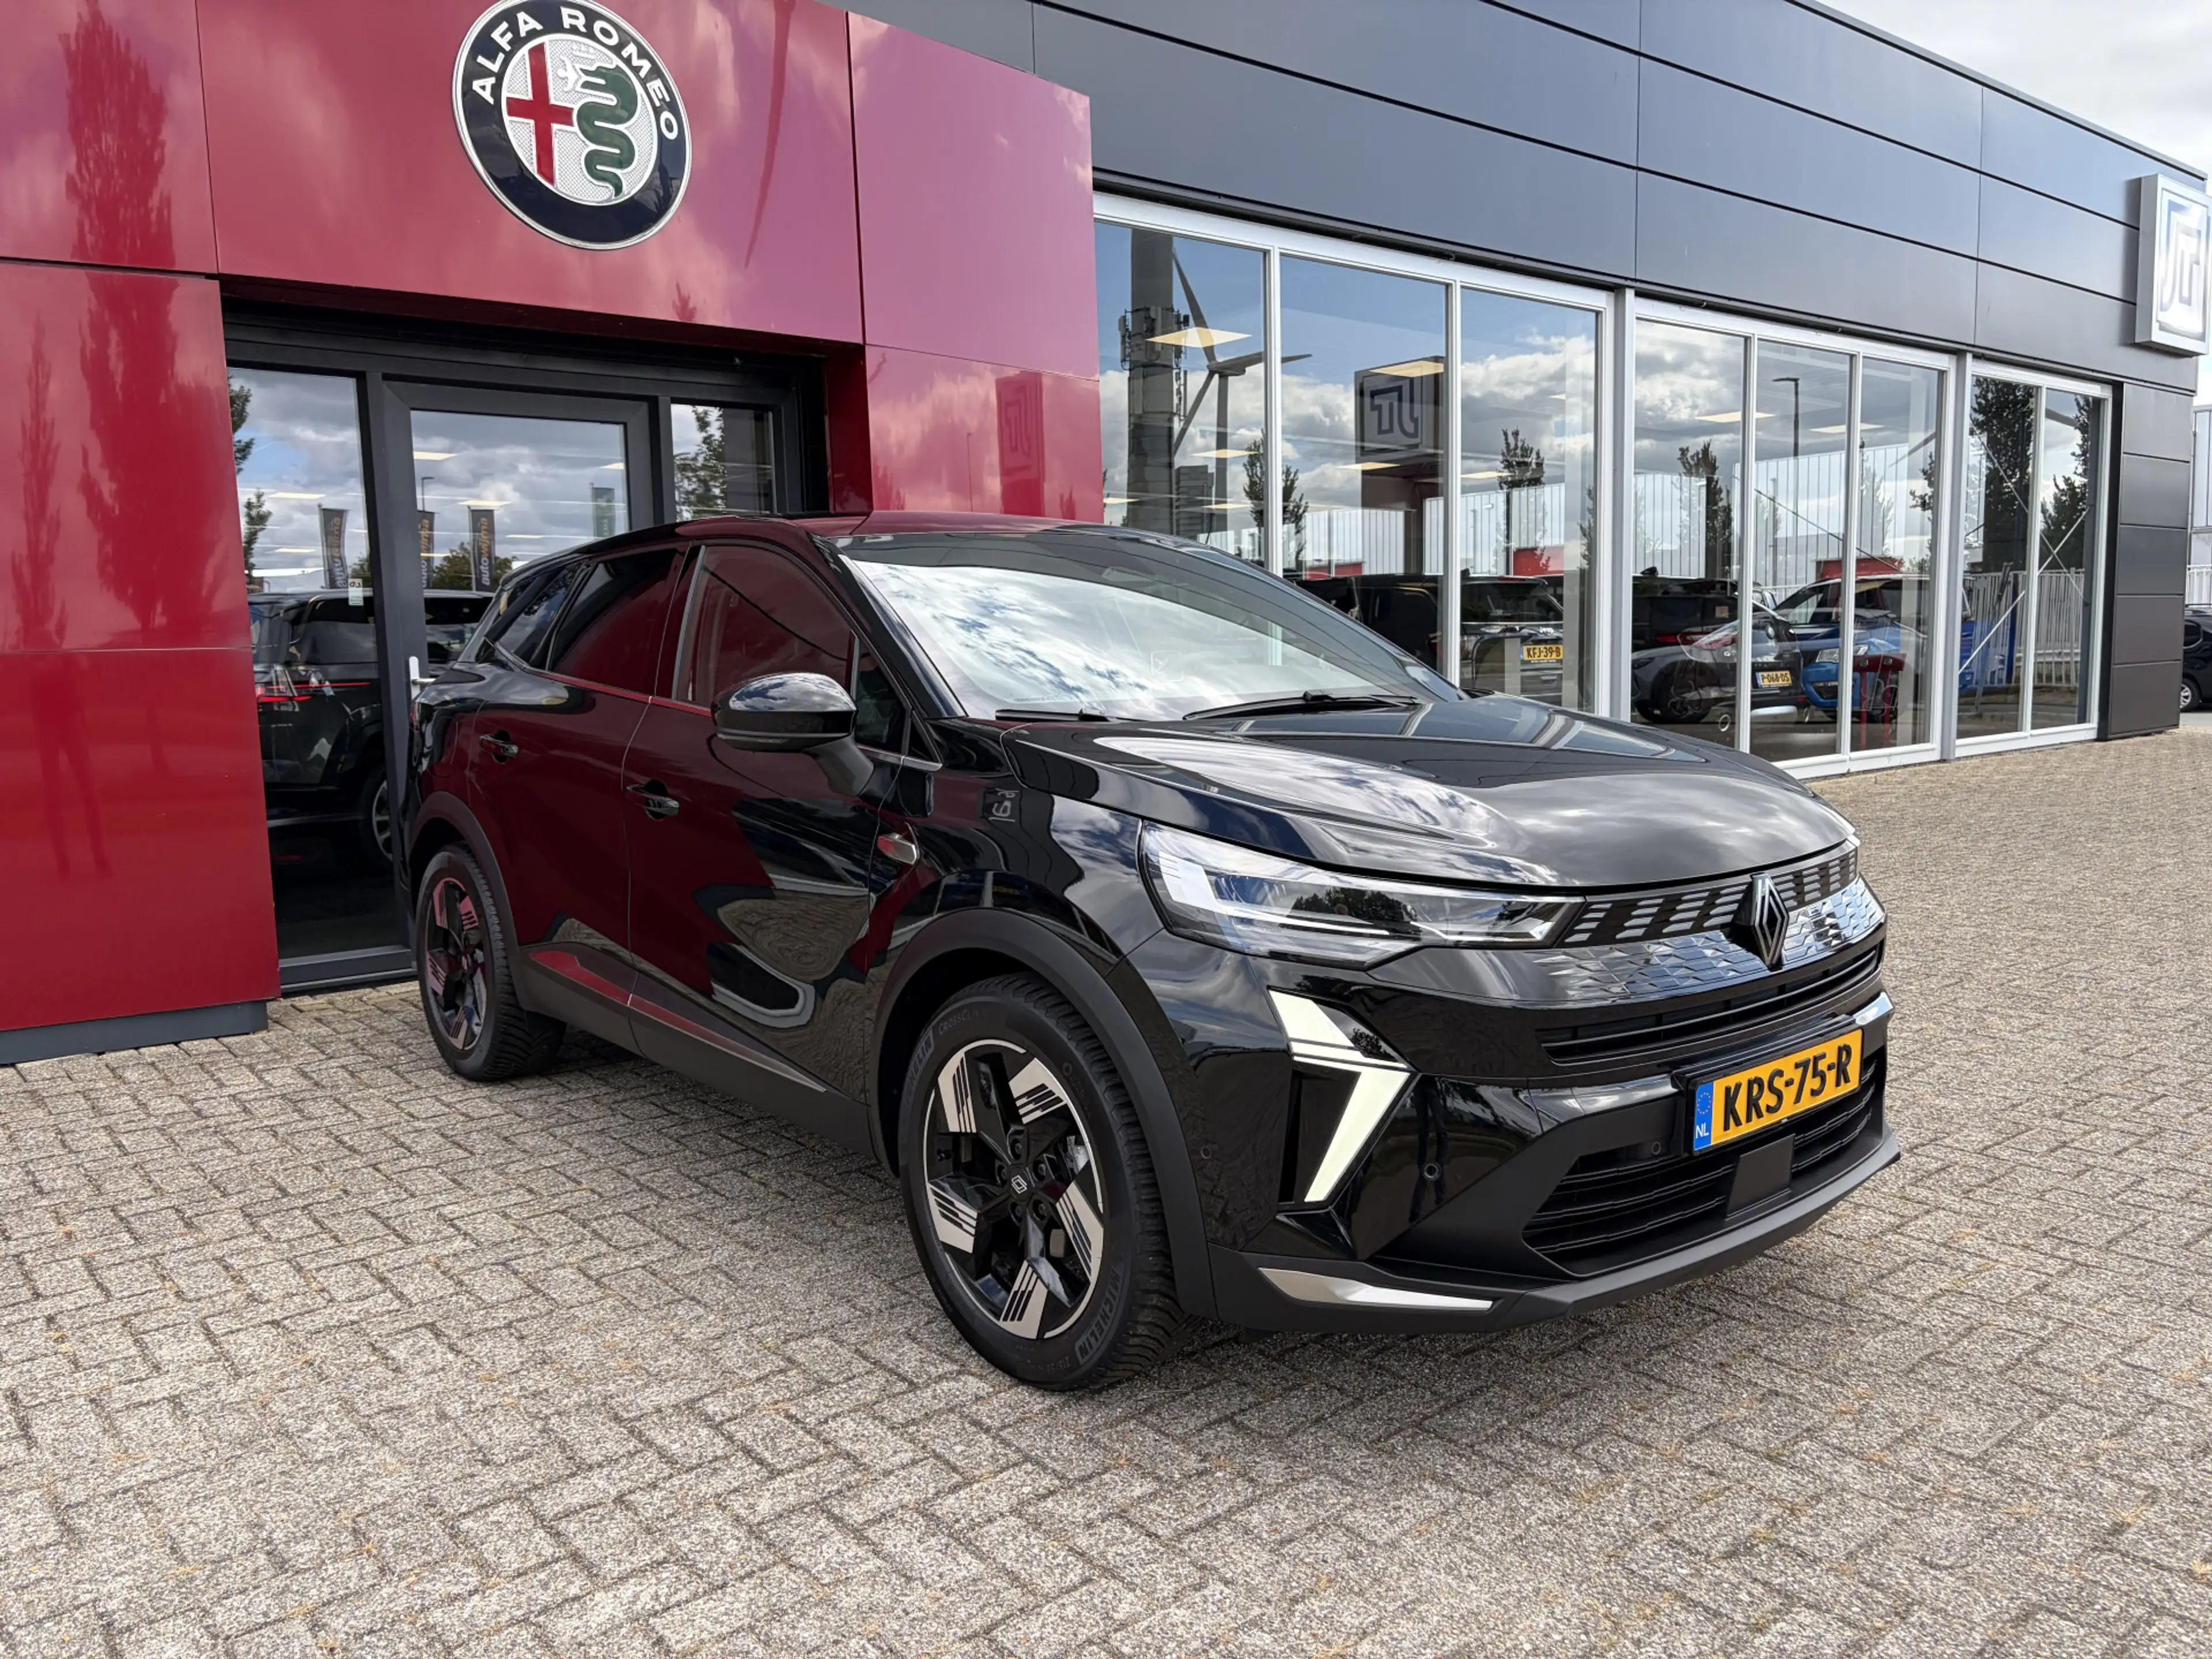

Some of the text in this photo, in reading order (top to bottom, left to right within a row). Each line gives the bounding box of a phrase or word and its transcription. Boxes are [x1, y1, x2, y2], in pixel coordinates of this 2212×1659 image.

[472, 6, 678, 141] ALFA ROMEO
[479, 517, 492, 586] autowijma
[1527, 646, 1561, 658] KFJ-39-B
[1723, 1043, 1853, 1131] KRS-75-R
[1695, 1122, 1709, 1139] NL
[1078, 1269, 1120, 1359] MICHELIN
